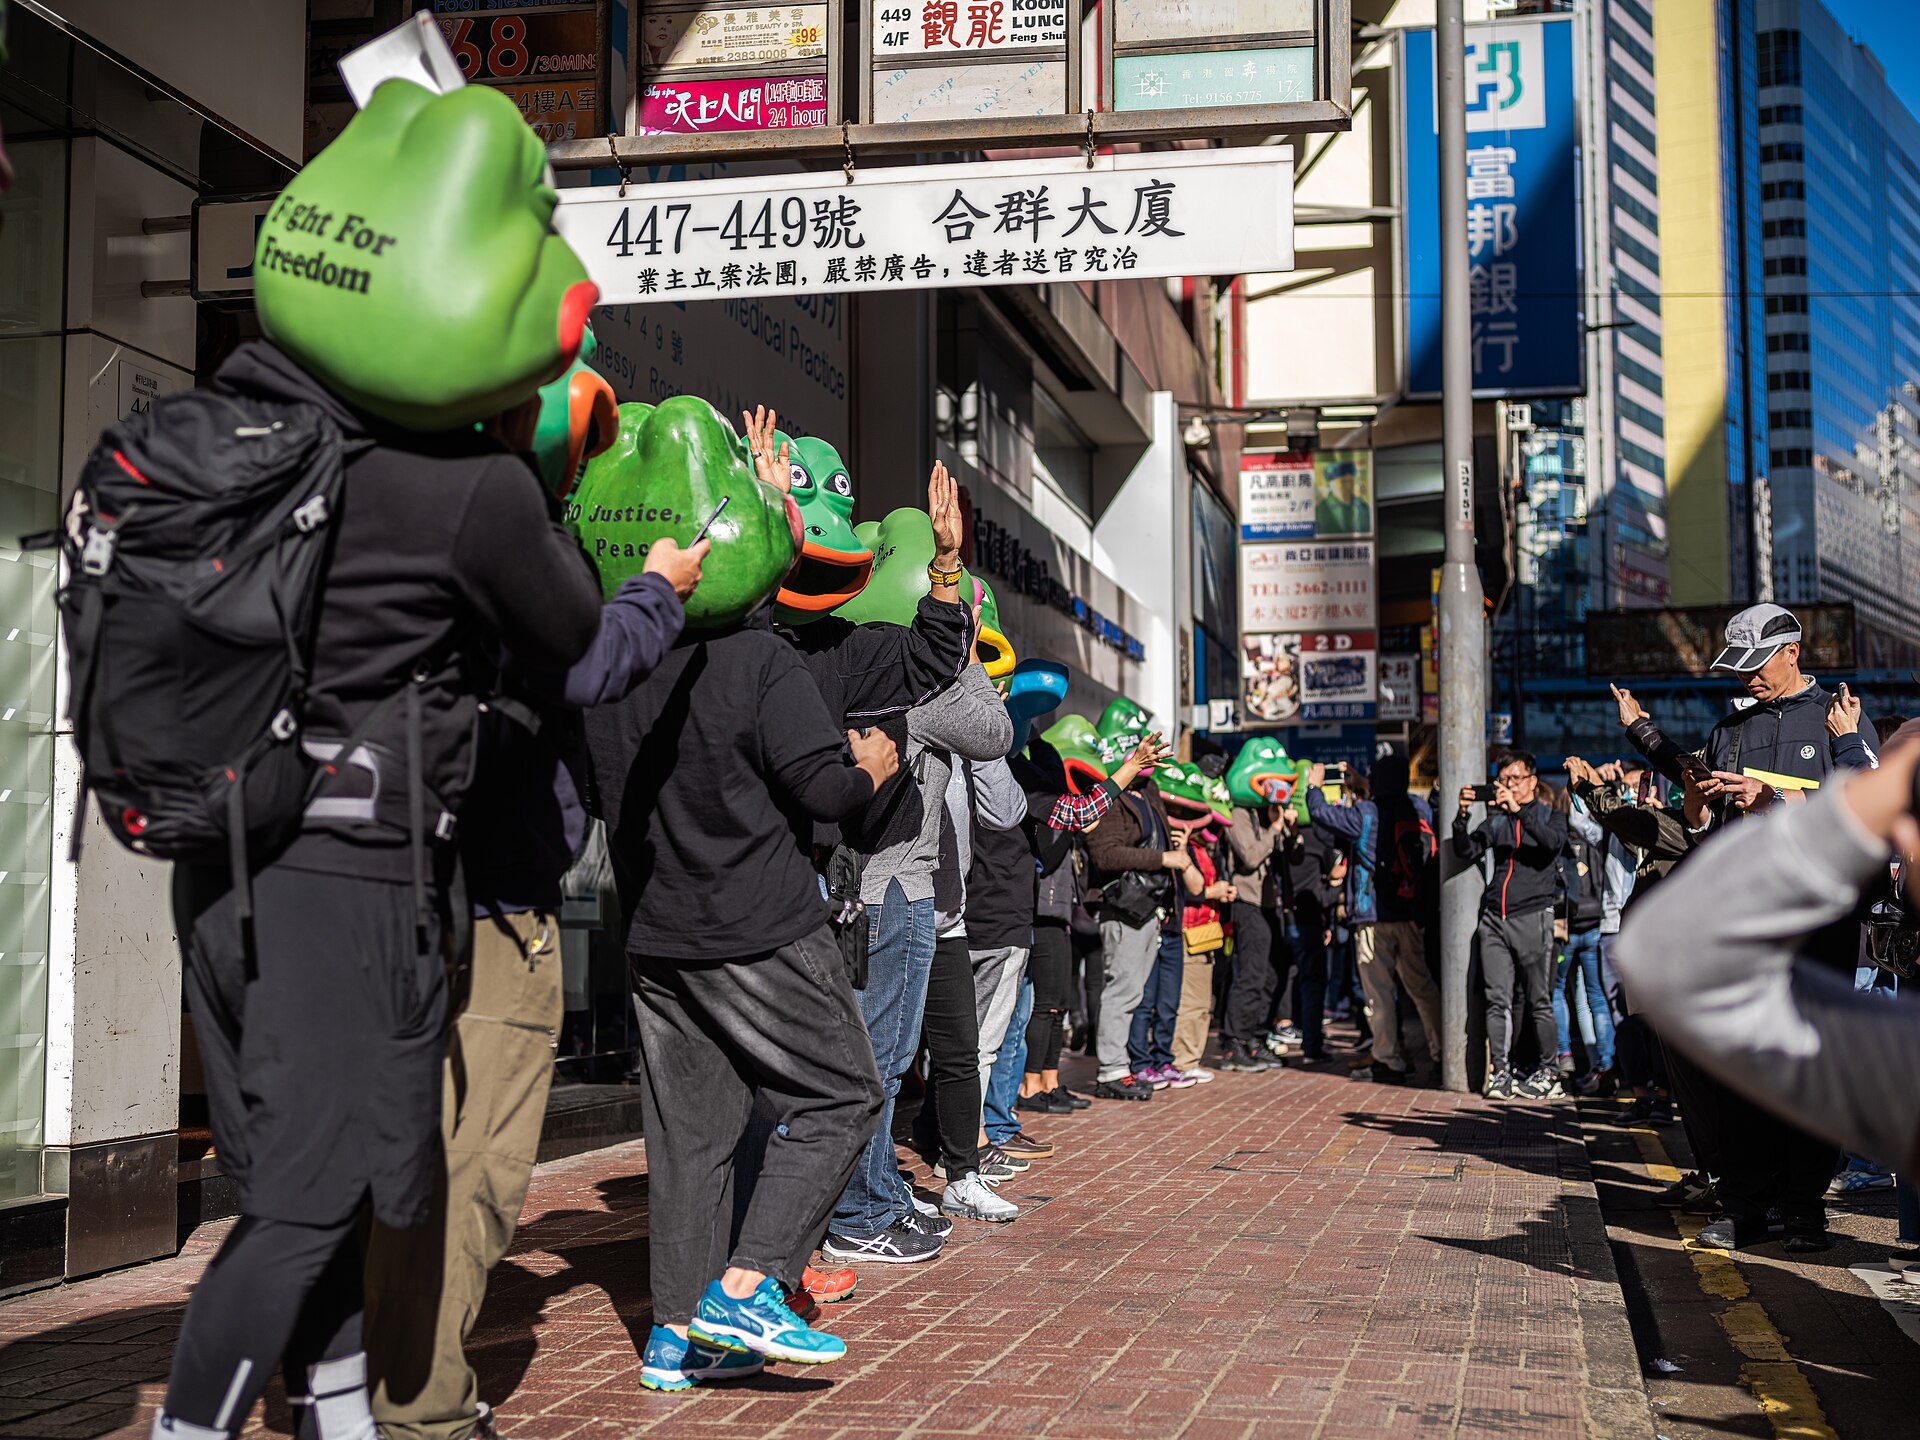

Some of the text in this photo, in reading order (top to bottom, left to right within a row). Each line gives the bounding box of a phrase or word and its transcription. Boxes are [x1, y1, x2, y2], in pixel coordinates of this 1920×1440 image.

[1012, 0, 1064, 11] KOON
[724, 8, 804, 25] 優雅美容
[880, 8, 911, 22] 449
[1012, 15, 1064, 29] LUNG
[723, 24, 753, 33] ELEGANT
[756, 23, 781, 31] BEAUTY
[921, 0, 1006, 49] 觀龍
[796, 28, 817, 43] $98
[883, 32, 909, 46] 4/F
[1010, 31, 1066, 43] Feng Shui
[727, 50, 756, 61] 2383
[758, 48, 788, 60] 0008
[644, 84, 676, 99] Sky spa
[1182, 90, 1262, 104] Tel: 9156 5775
[503, 88, 596, 114] 4樓A室
[767, 107, 787, 127] 24
[932, 178, 1186, 245] 合群大廈
[271, 195, 397, 256] Fght For
[261, 235, 371, 295] Freedom
[1466, 145, 1520, 374] 富邦銀行
[597, 340, 637, 389] nessy
[790, 324, 845, 400] Practice
[131, 397, 151, 414] 44
[587, 502, 683, 525] Justice,
[595, 537, 650, 558] Peac
[1295, 581, 1367, 596] 2662-1111
